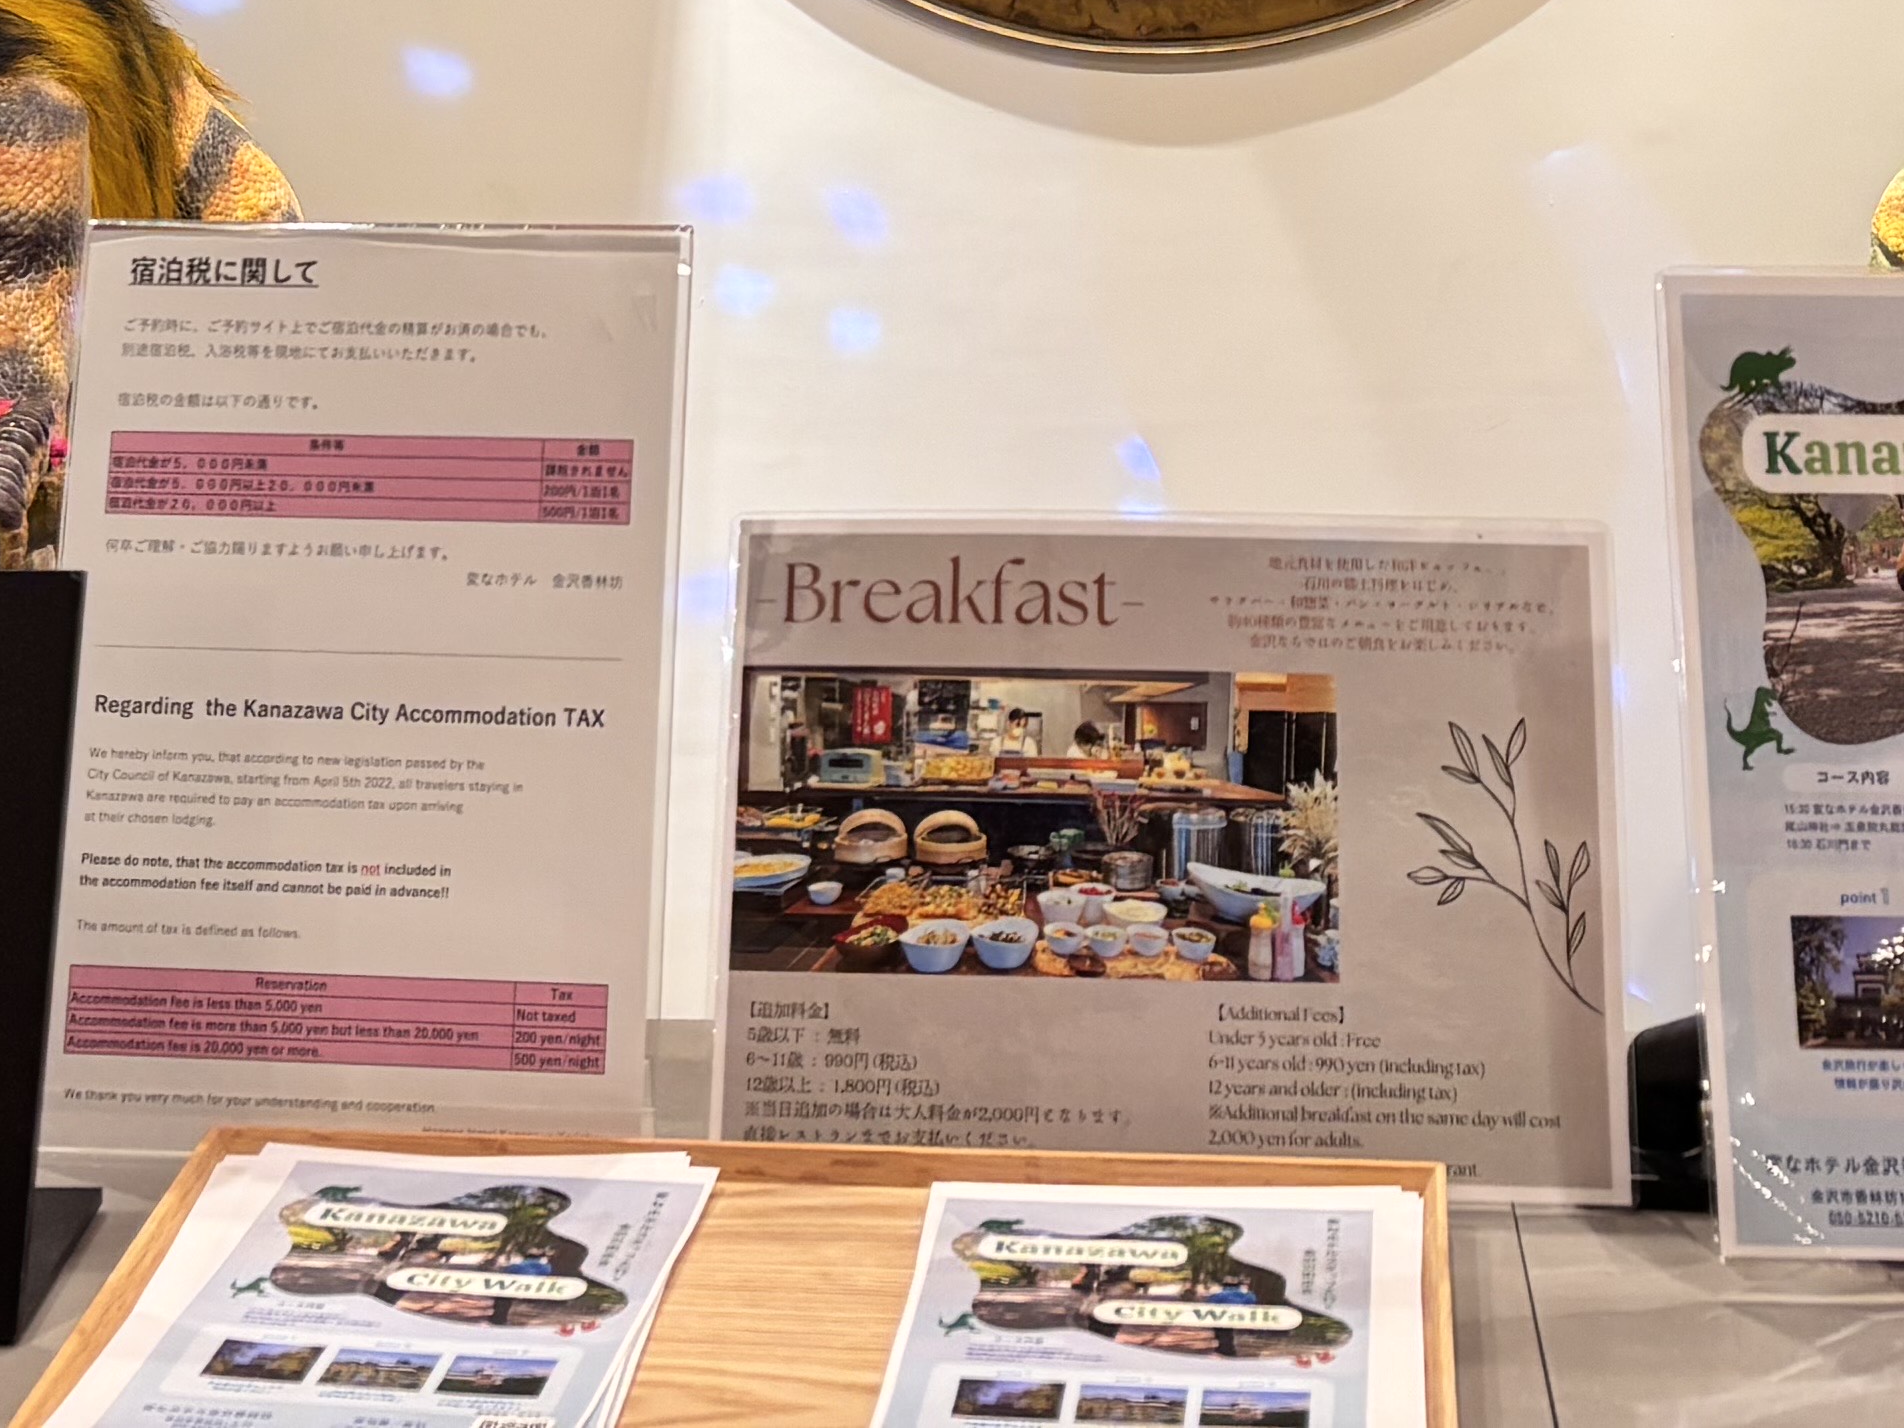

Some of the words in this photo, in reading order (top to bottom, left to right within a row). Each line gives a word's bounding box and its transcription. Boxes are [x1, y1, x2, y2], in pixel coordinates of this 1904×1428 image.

[128, 255, 319, 289] 宿泊税に関して
[94, 694, 194, 720] Regarding
[205, 697, 237, 718] the
[243, 698, 344, 720] Kanazawa
[350, 701, 390, 726] City
[394, 703, 557, 727] Accommodation
[563, 707, 605, 728] TAX
[1817, 771, 1890, 784] コース内容
[80, 852, 121, 866] Please
[123, 854, 140, 867] do
[142, 855, 173, 869] note,
[175, 855, 200, 869] that
[203, 857, 224, 870] the
[226, 859, 323, 873] accommodation
[325, 862, 344, 874] tax
[347, 861, 358, 874] is
[360, 864, 381, 876] not
[384, 863, 437, 877] included
[439, 864, 452, 877] in
[79, 874, 99, 887] the
[101, 876, 197, 890] accommodation
[200, 877, 220, 891] fee
[222, 878, 254, 892] itself
[255, 880, 280, 893] and
[281, 883, 324, 895] cannot
[326, 882, 343, 896] be
[344, 884, 372, 897] paid
[374, 884, 387, 896] in
[1841, 892, 1876, 905] point
[319, 1206, 498, 1233] Kanazawa
